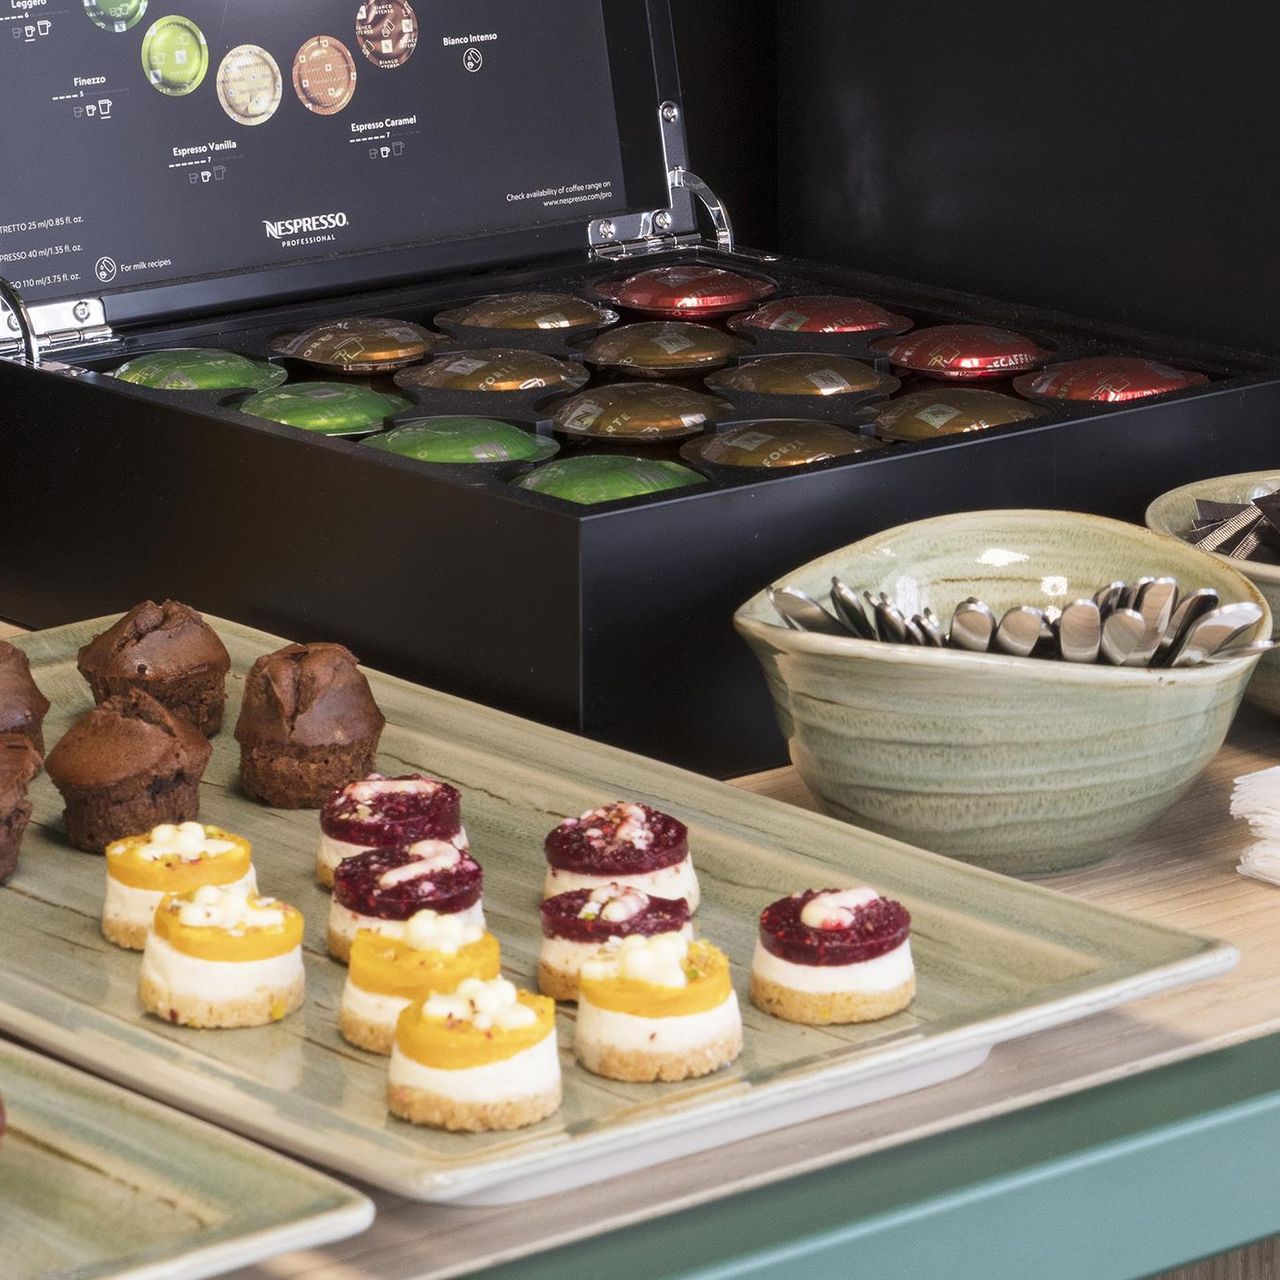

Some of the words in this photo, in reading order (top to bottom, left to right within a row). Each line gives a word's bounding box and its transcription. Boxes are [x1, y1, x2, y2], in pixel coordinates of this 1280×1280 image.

[443, 36, 468, 46] Bianco
[470, 33, 498, 42] Intenso
[73, 76, 106, 87] Finezzo
[351, 122, 384, 134] Espresso
[384, 115, 417, 128] Caramel
[173, 146, 208, 158] Espresso
[208, 140, 237, 151] Vanilla
[506, 192, 525, 201] Check
[526, 188, 557, 199] availability
[558, 186, 565, 194] of
[566, 183, 584, 193] coffee
[585, 182, 602, 190] range
[544, 191, 612, 207] www.nespresso.com/pro
[28, 221, 36, 230] 25
[38, 217, 64, 229] ml/0.85
[73, 216, 84, 224] oz.
[281, 234, 336, 248] PROFESSIONAL
[28, 250, 38, 258] 40
[38, 246, 64, 257] ml/1.35
[120, 264, 132, 273] For
[133, 261, 148, 272] milk
[148, 258, 172, 270] recipes
[22, 279, 34, 288] 110
[36, 275, 62, 286] ml/3.75
[762, 438, 806, 468] FORTE
